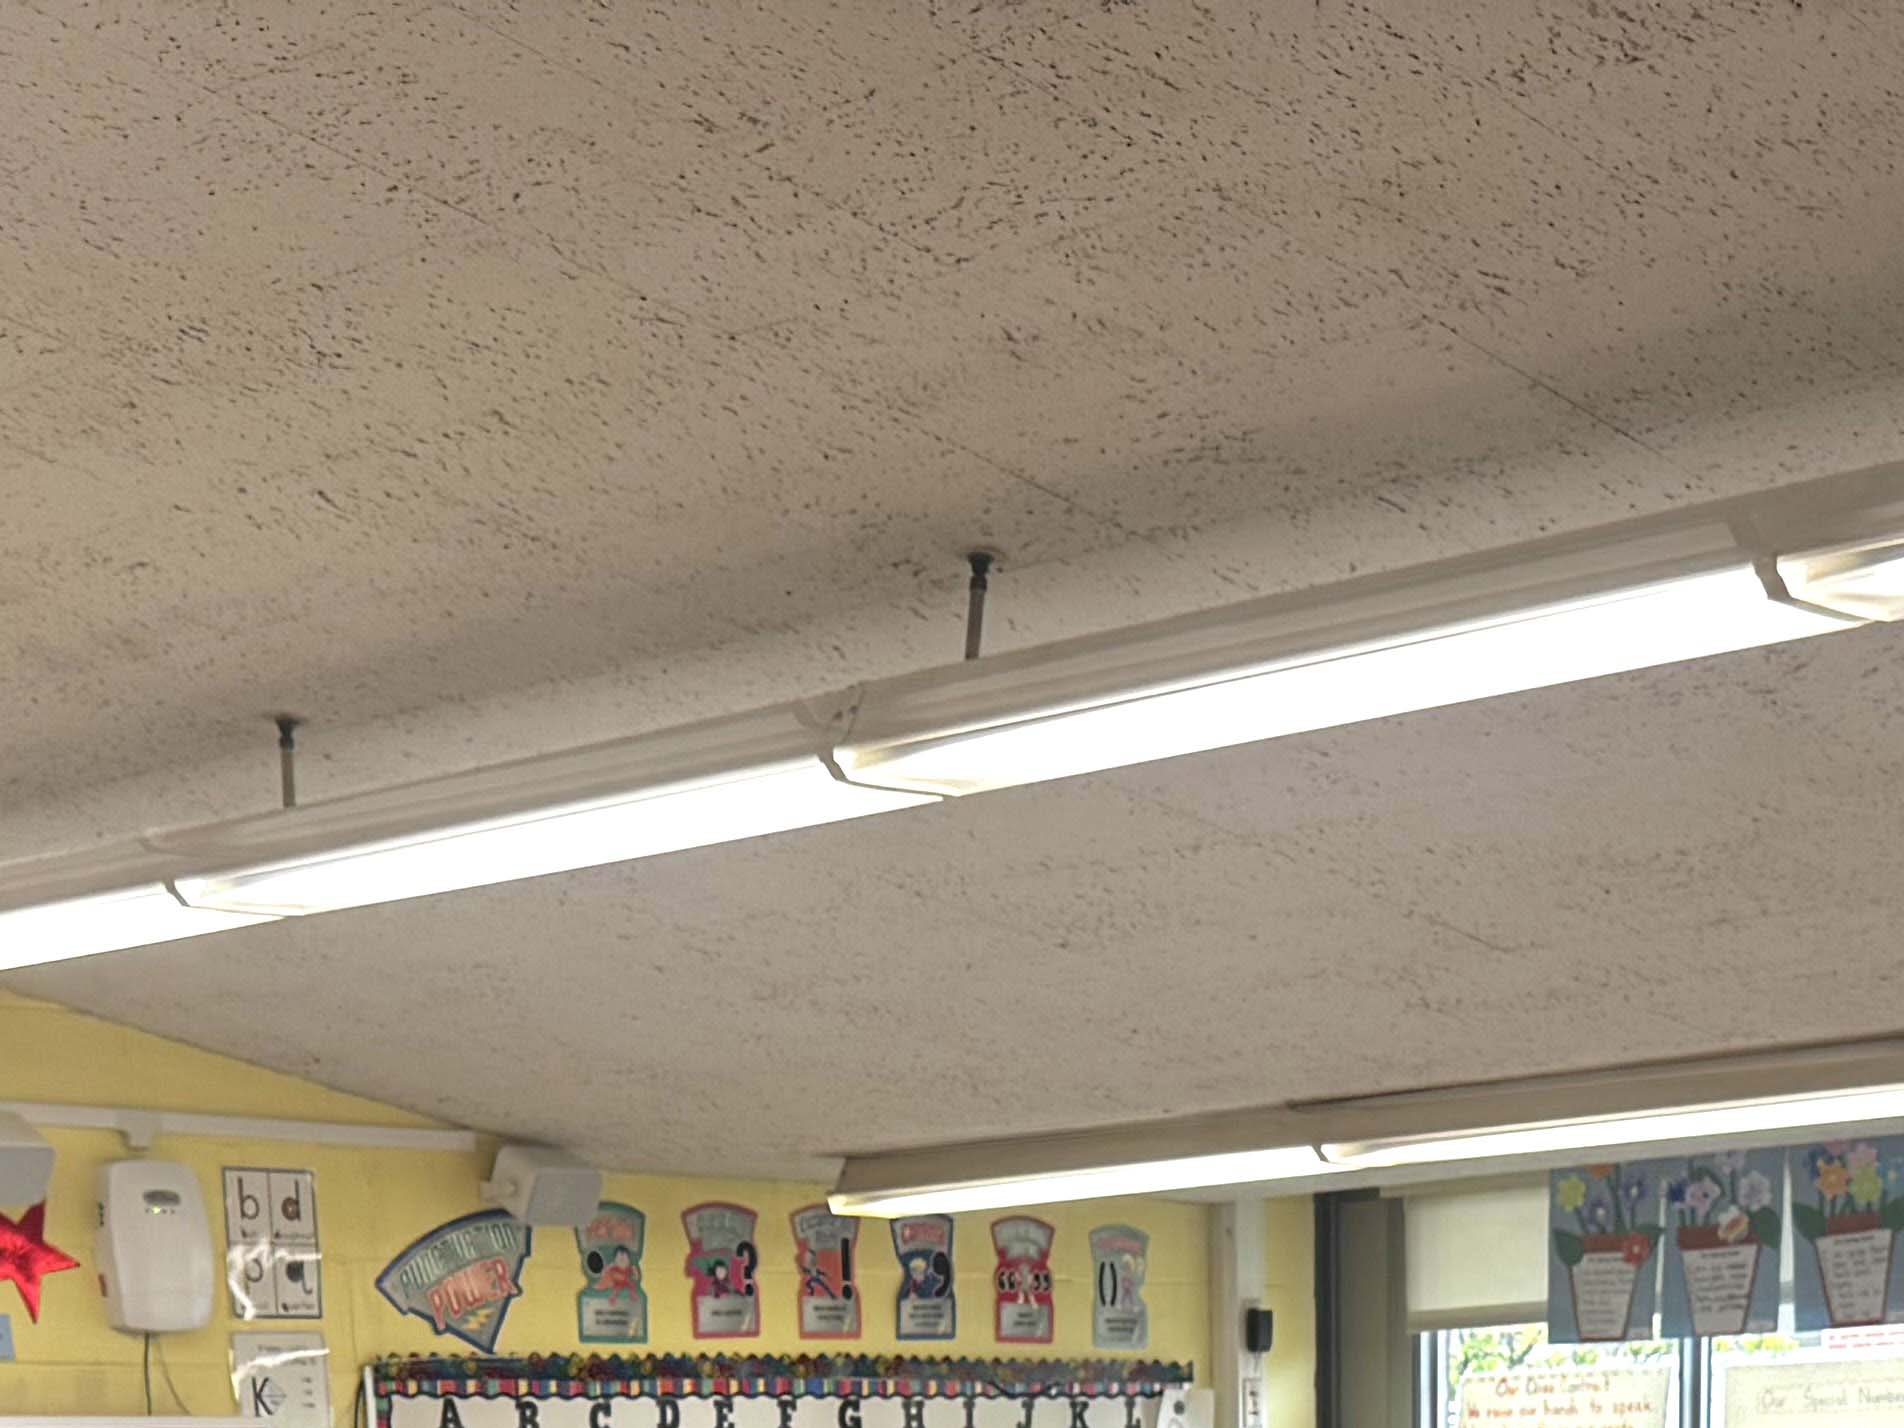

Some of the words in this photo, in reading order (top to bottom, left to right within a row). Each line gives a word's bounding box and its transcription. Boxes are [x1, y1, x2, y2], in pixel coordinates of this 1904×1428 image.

[238, 1177, 259, 1220] b
[281, 1179, 301, 1221] d
[429, 1258, 517, 1330] POWER
